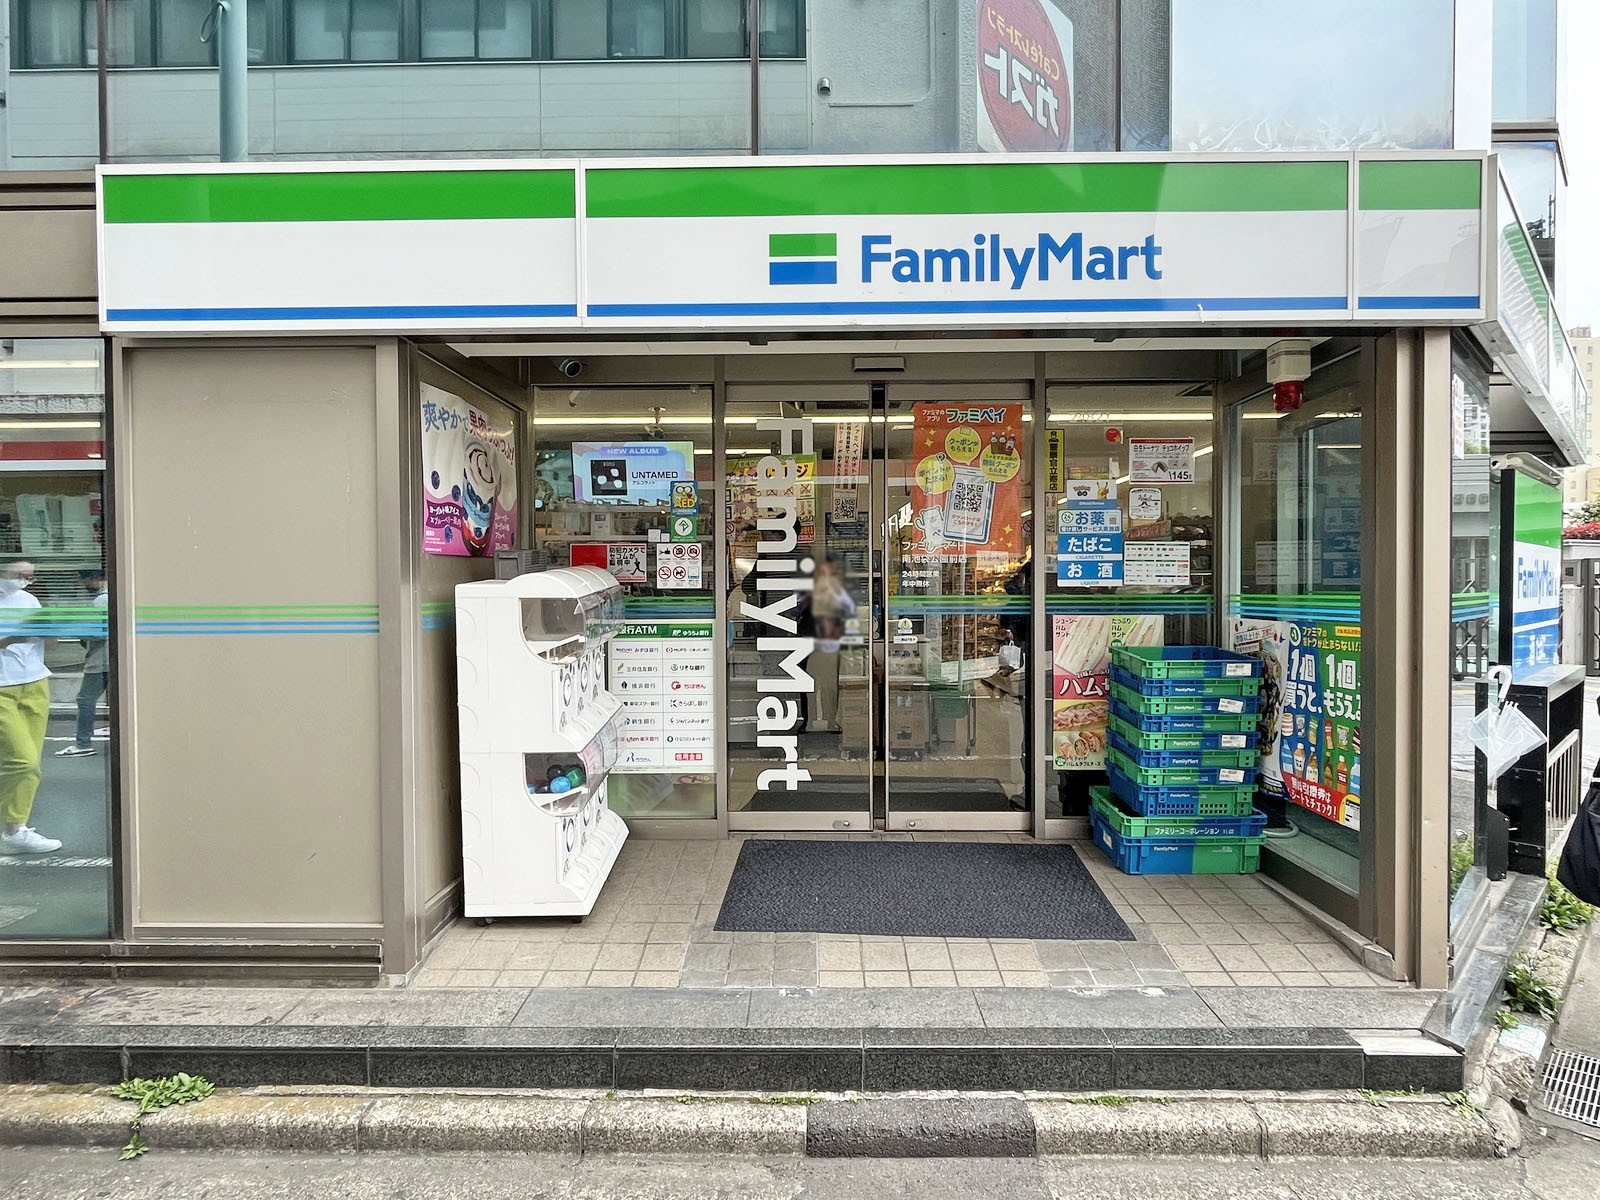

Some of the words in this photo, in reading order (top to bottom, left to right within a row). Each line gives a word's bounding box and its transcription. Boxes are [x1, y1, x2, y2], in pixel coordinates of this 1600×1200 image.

[861, 232, 1162, 290] FamilyMart
[946, 407, 1006, 423] ファミペイ
[948, 438, 979, 447] クーポンが
[631, 471, 678, 479] UNTAMED
[674, 498, 695, 508] AED
[1075, 511, 1105, 525] お薬
[1067, 537, 1112, 552] たばこ
[902, 554, 967, 564] 南池袋公園前店
[1518, 556, 1558, 605] FamilyMart
[740, 418, 815, 791] FamilyMart
[1155, 827, 1220, 835] ファミリーコーポレーション
